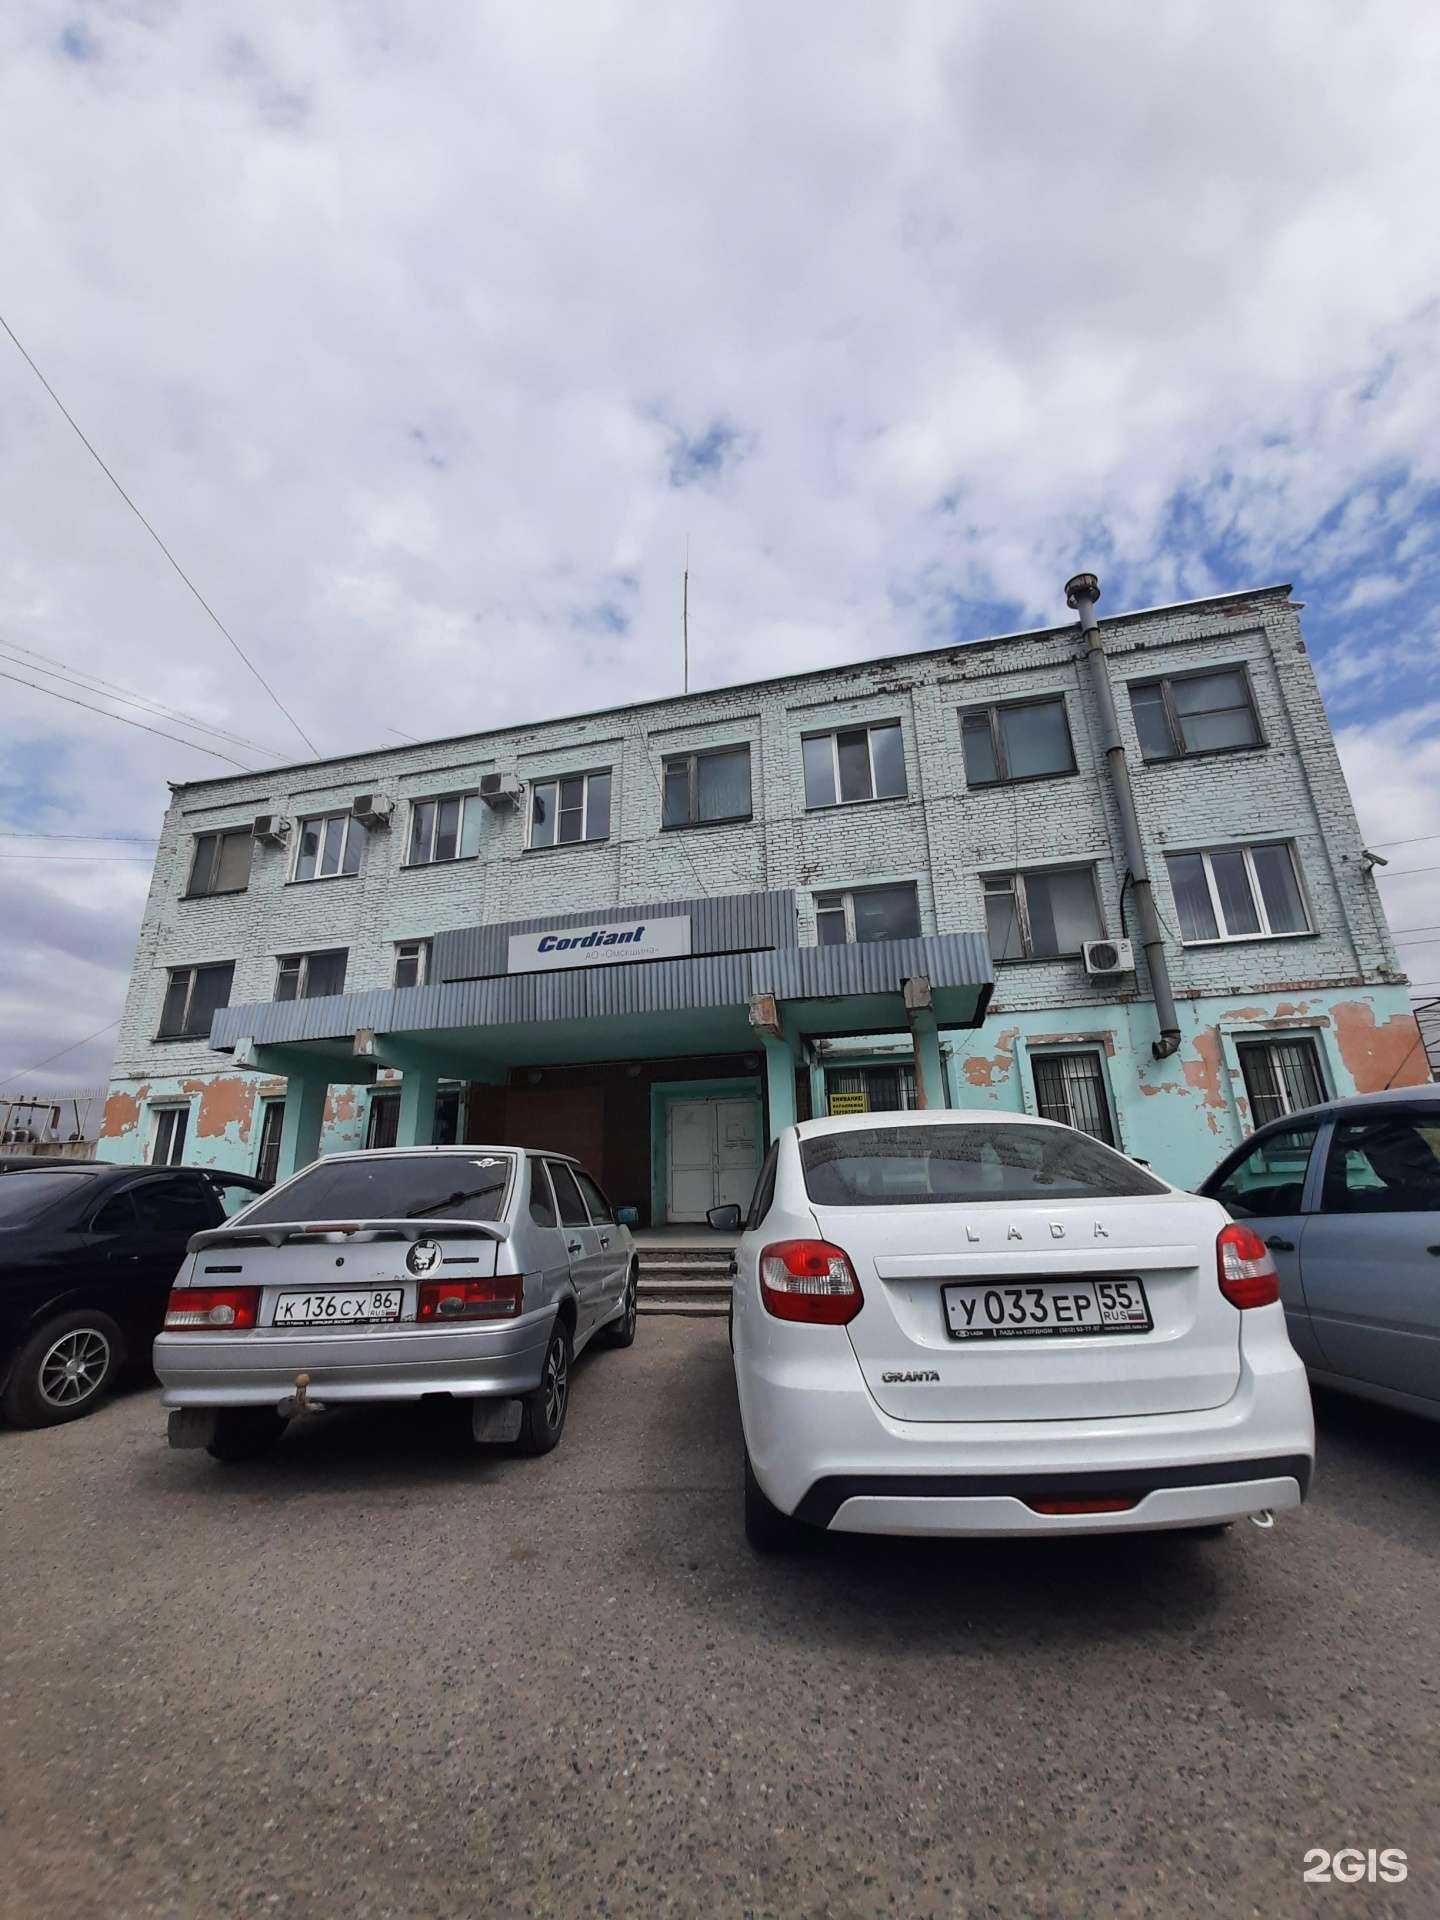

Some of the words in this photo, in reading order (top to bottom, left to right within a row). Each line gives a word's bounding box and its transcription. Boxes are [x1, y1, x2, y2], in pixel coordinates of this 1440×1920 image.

[537, 926, 646, 953] Cordiant
[965, 1220, 1110, 1243] LADA
[1104, 1310, 1128, 1321] RUS
[881, 1369, 941, 1384] GRANTA
